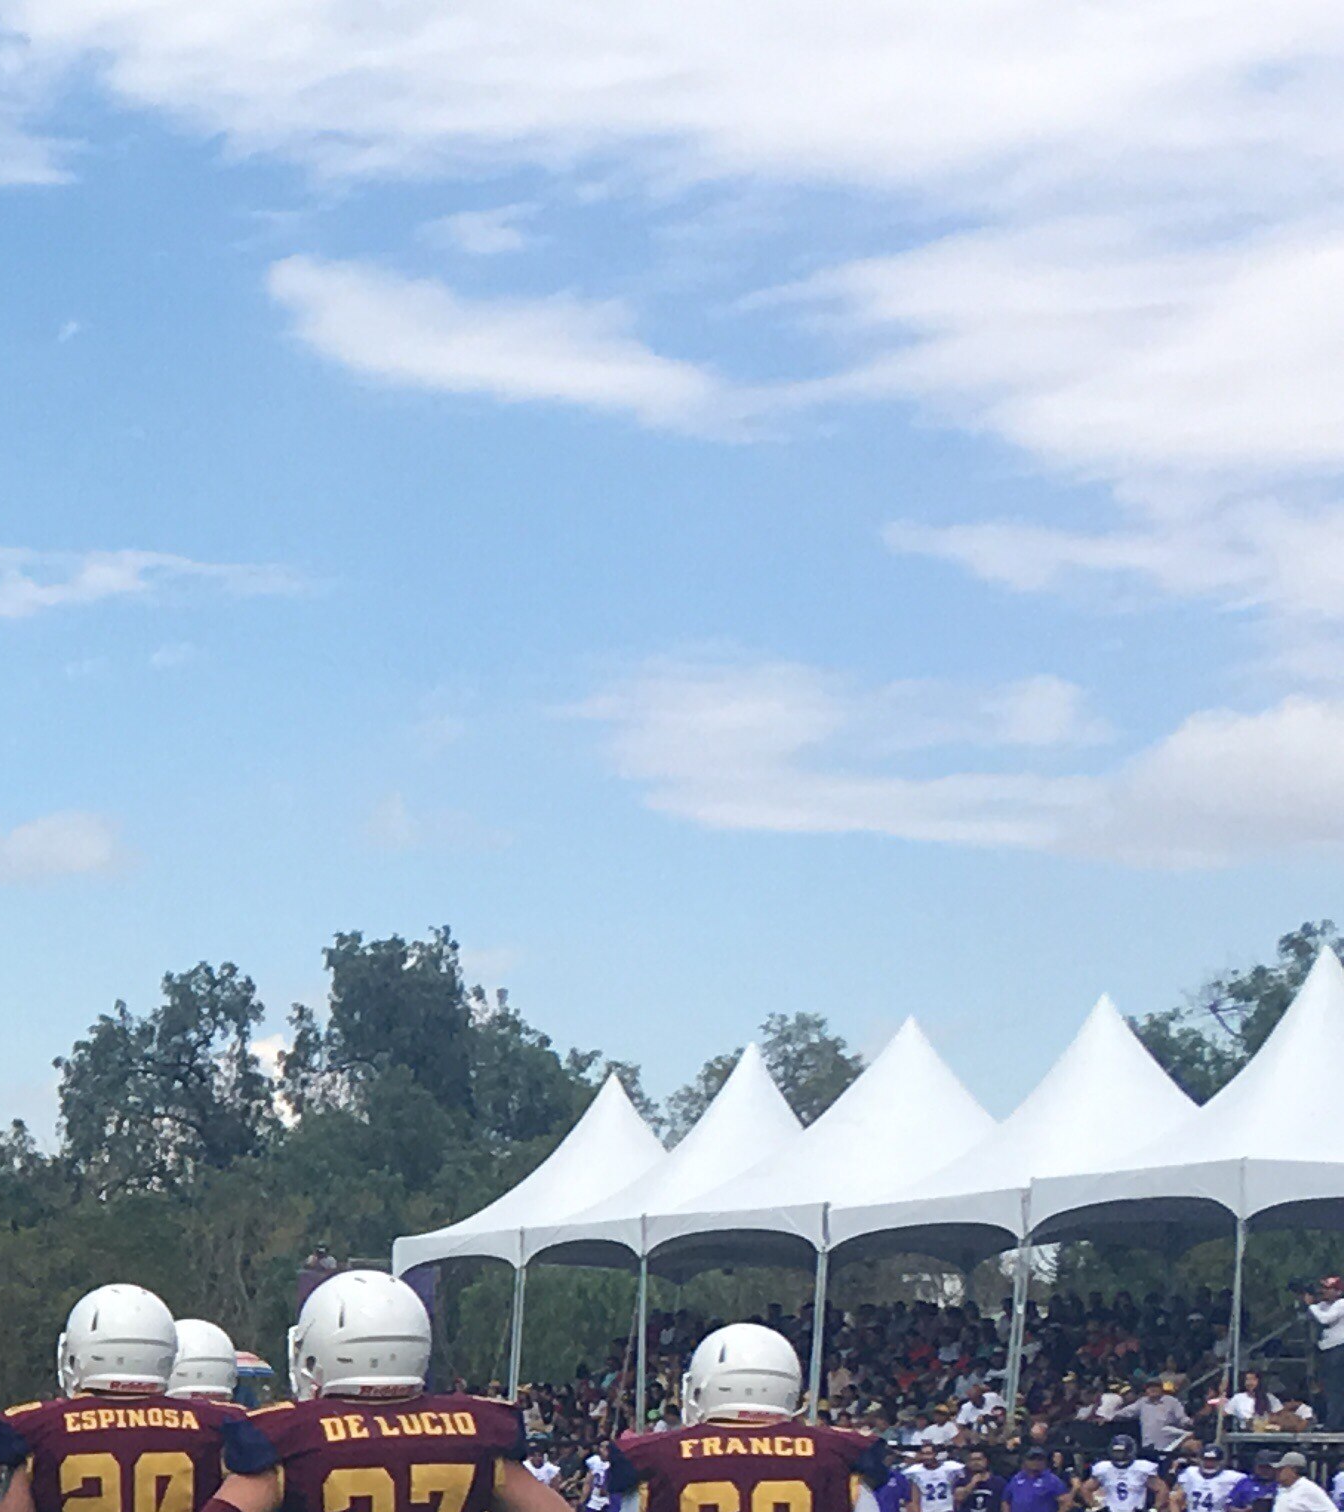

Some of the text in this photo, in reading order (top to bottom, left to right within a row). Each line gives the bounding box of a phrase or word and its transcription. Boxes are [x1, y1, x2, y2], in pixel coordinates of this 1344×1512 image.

[64, 1407, 200, 1433] ESPINOSA
[319, 1411, 477, 1442] DE LUCIO
[680, 1436, 814, 1459] FRANCO
